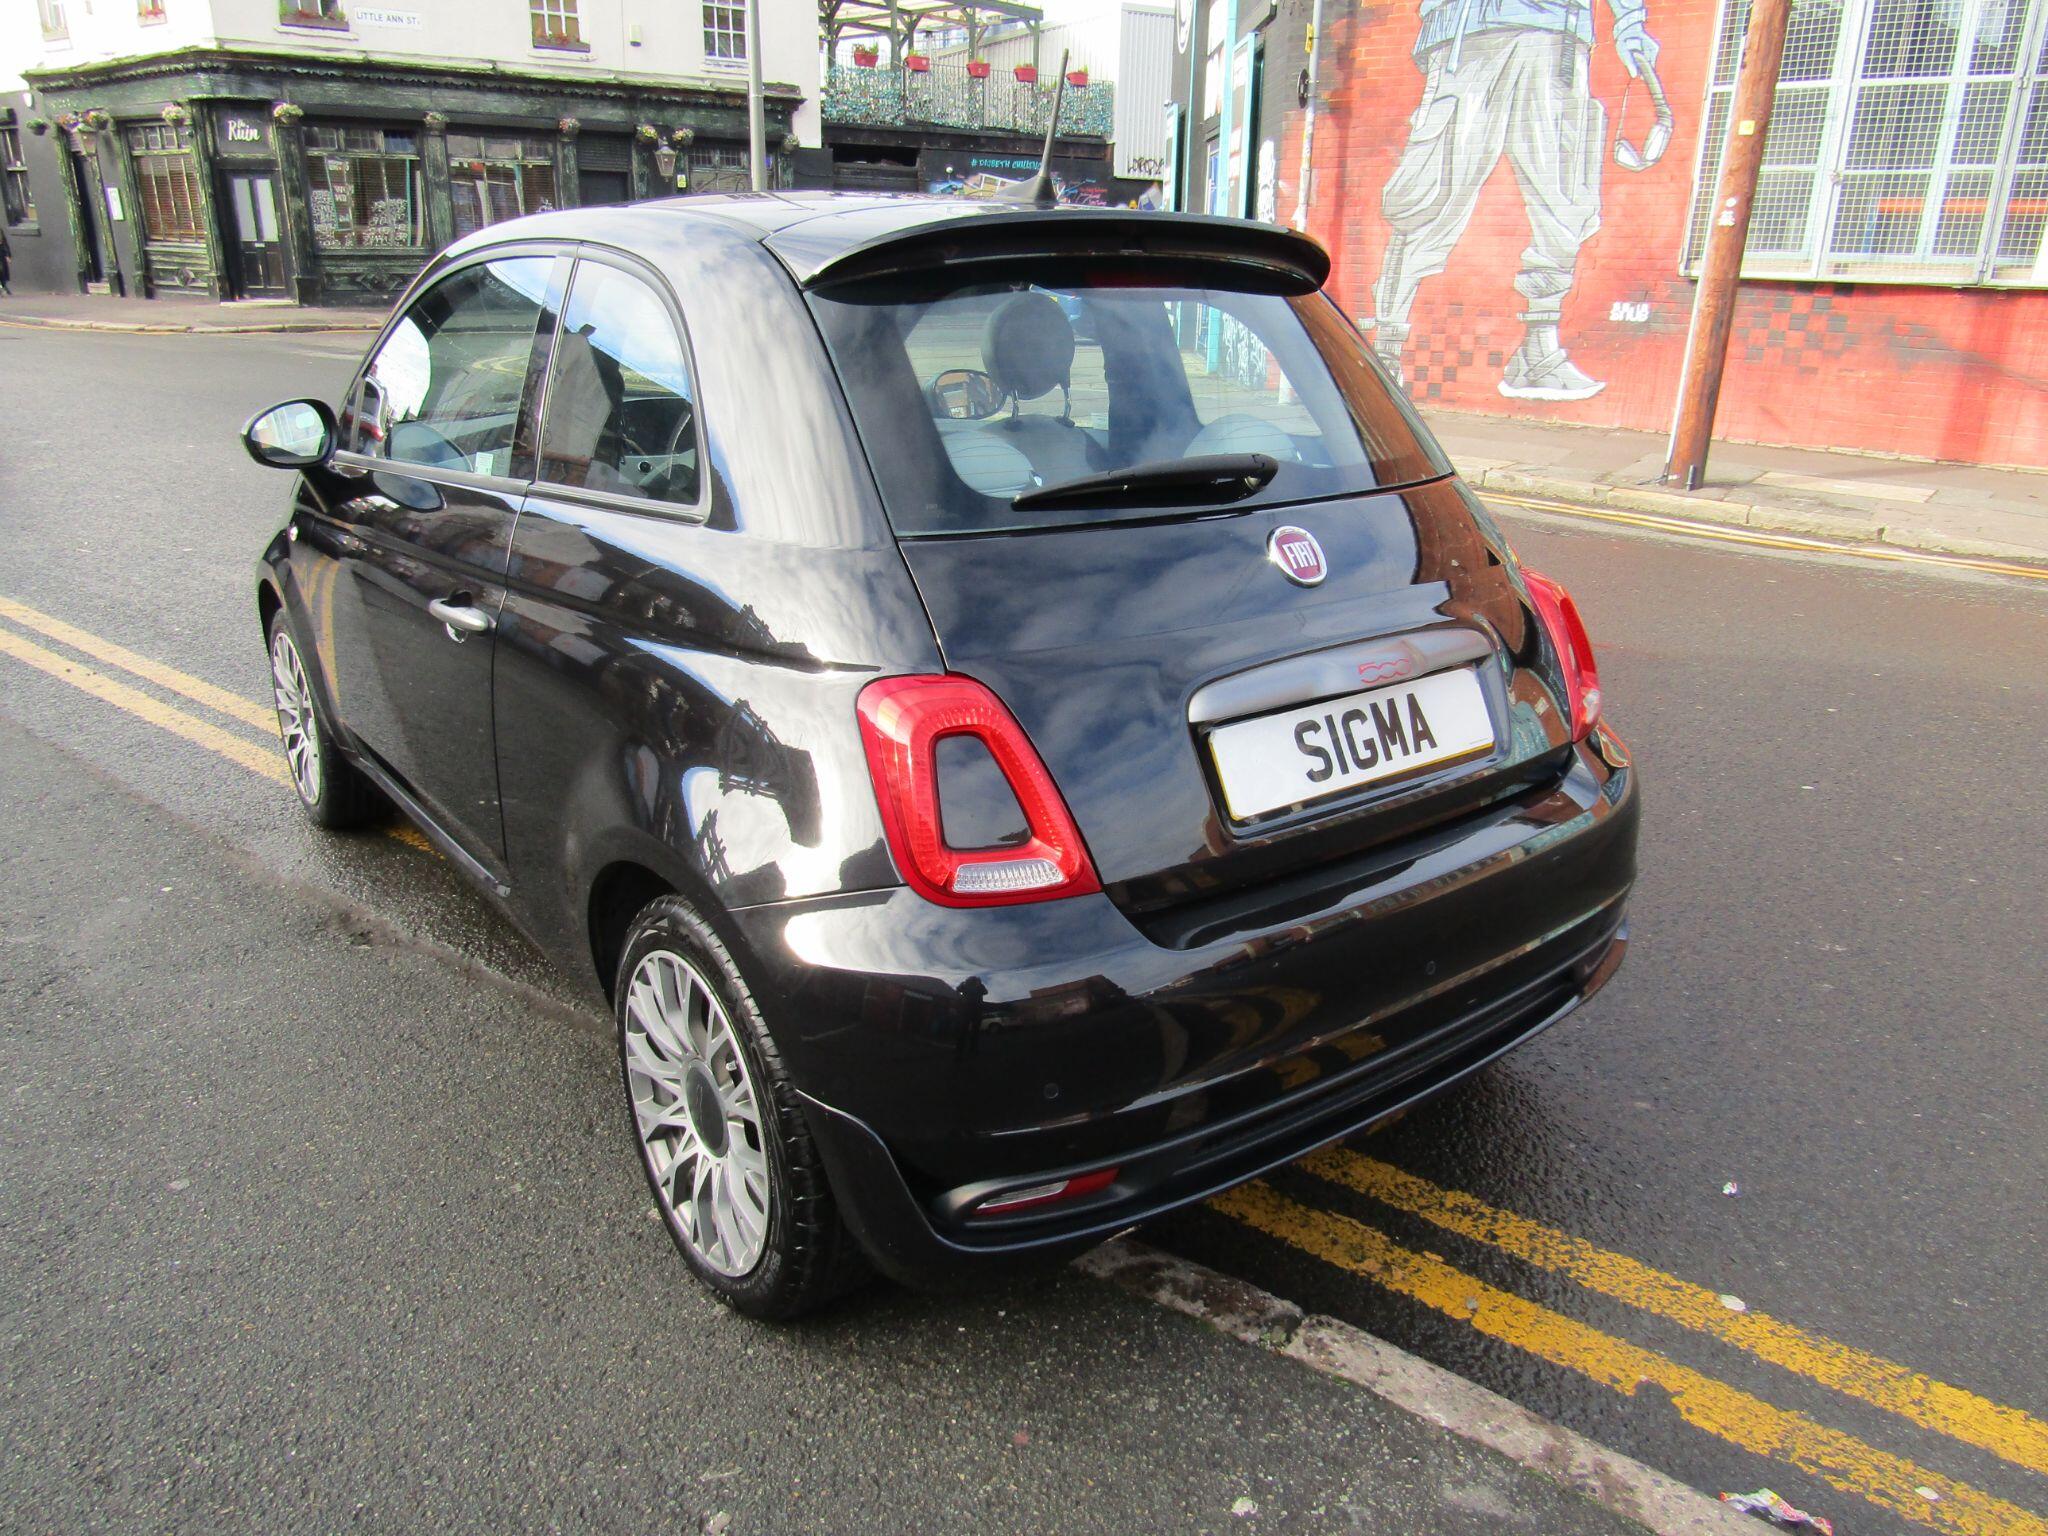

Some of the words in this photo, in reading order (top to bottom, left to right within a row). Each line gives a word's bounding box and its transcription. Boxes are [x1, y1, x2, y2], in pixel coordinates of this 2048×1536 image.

[356, 11, 383, 22] LITTLE
[386, 14, 404, 24] ANN
[228, 120, 260, 141] Ruin
[1282, 541, 1317, 570] FIAT
[1359, 658, 1412, 684] 500
[1293, 692, 1438, 783] SIGMA
